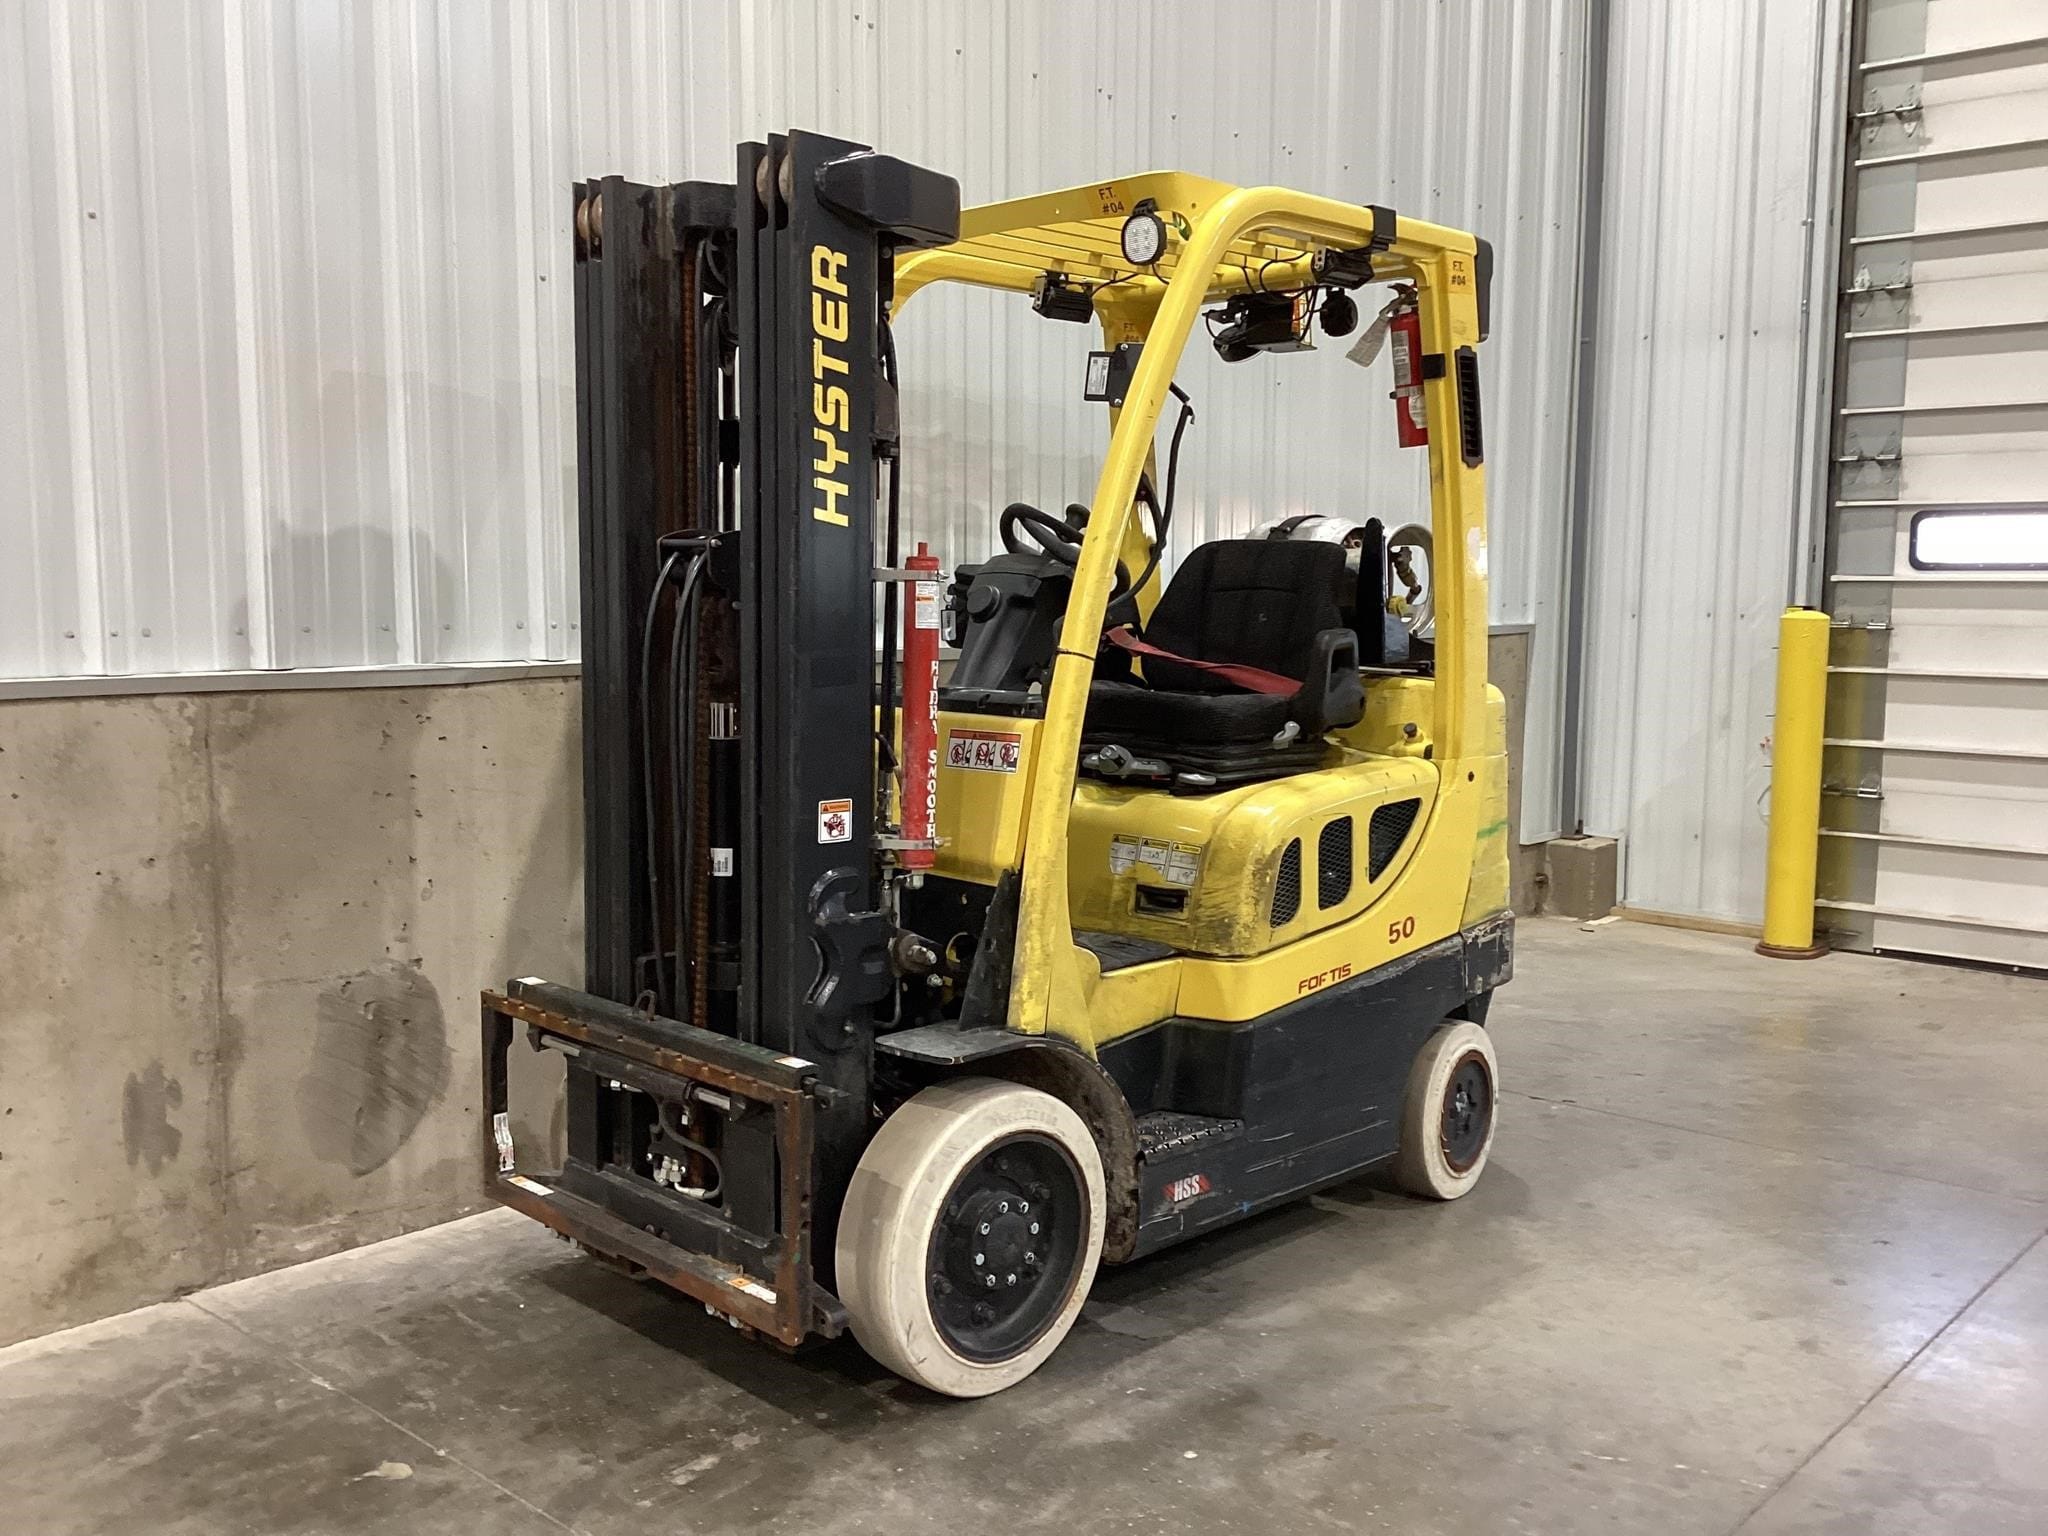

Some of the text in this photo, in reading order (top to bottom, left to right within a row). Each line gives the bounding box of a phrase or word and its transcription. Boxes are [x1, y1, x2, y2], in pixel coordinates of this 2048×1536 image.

[1098, 187, 1116, 200] F.T.
[1102, 201, 1124, 215] #04
[810, 244, 849, 527] HYSTER
[1388, 916, 1415, 945] 50
[1174, 1174, 1200, 1202] HSS
